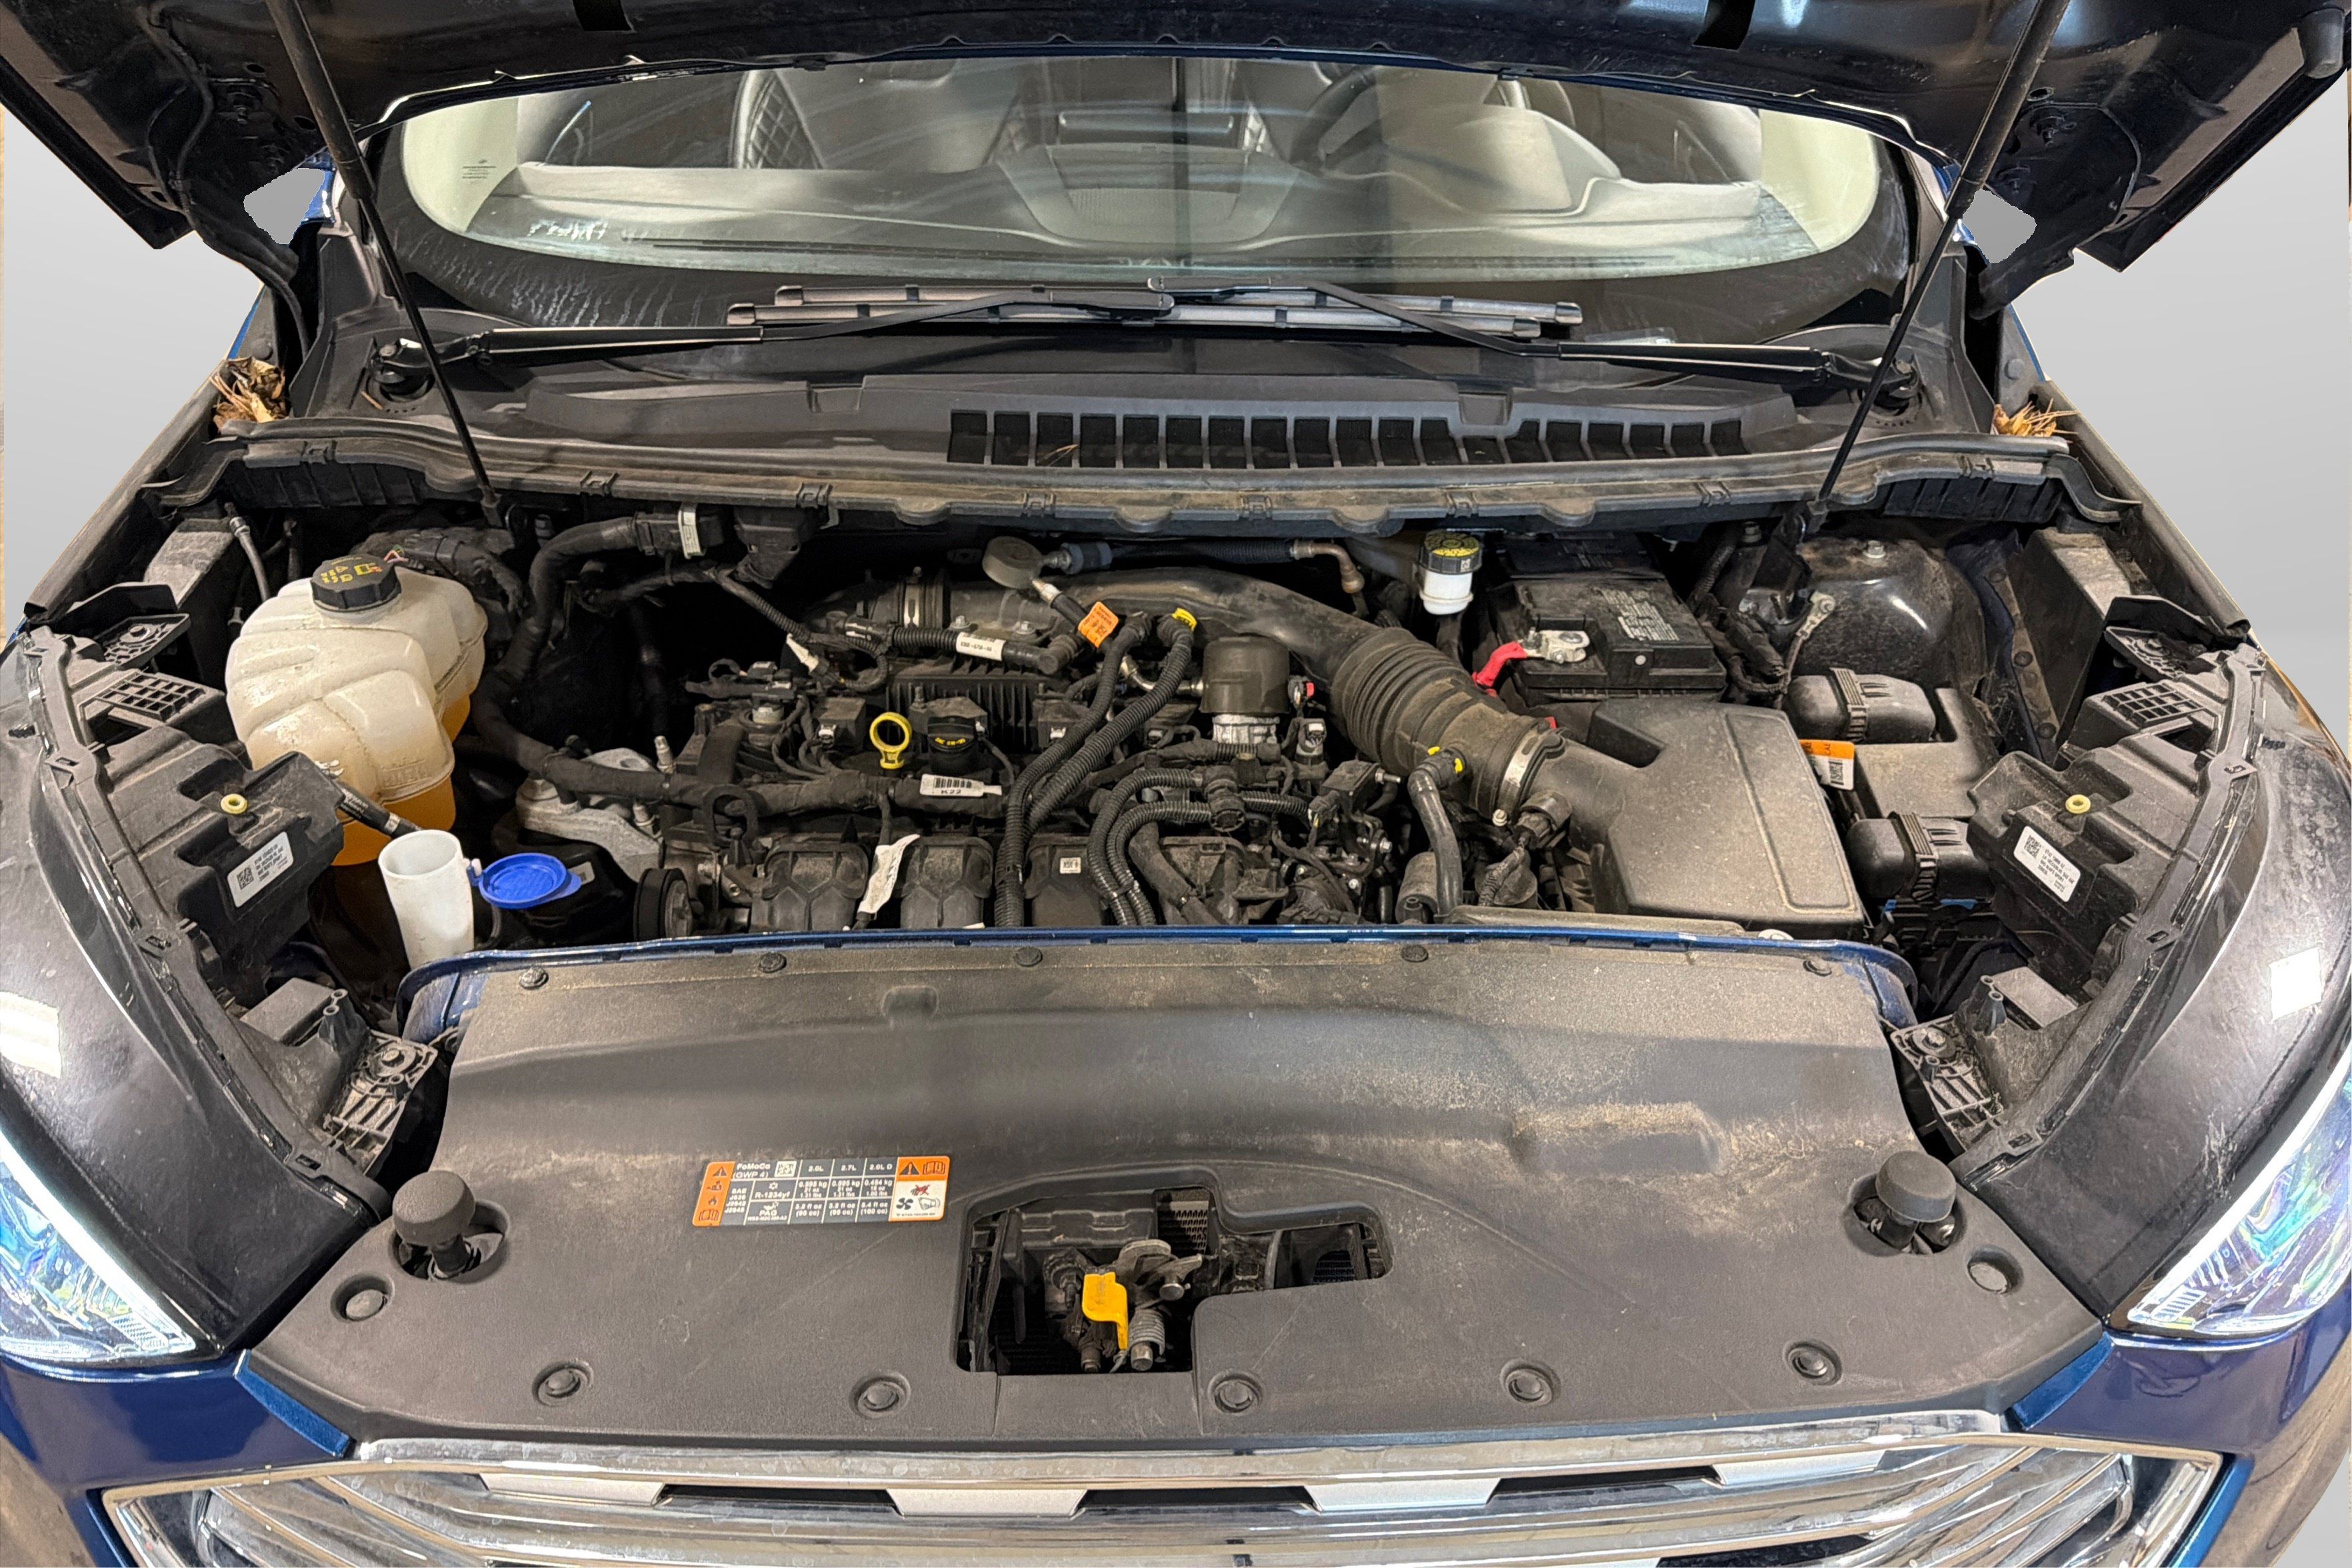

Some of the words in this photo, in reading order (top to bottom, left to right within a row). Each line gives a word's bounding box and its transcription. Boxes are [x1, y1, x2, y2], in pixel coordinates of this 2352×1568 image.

[818, 1181, 827, 1189] kg
[851, 1180, 860, 1188] kg
[884, 1179, 893, 1187] kg
[755, 1191, 791, 1199] R-1234yf
